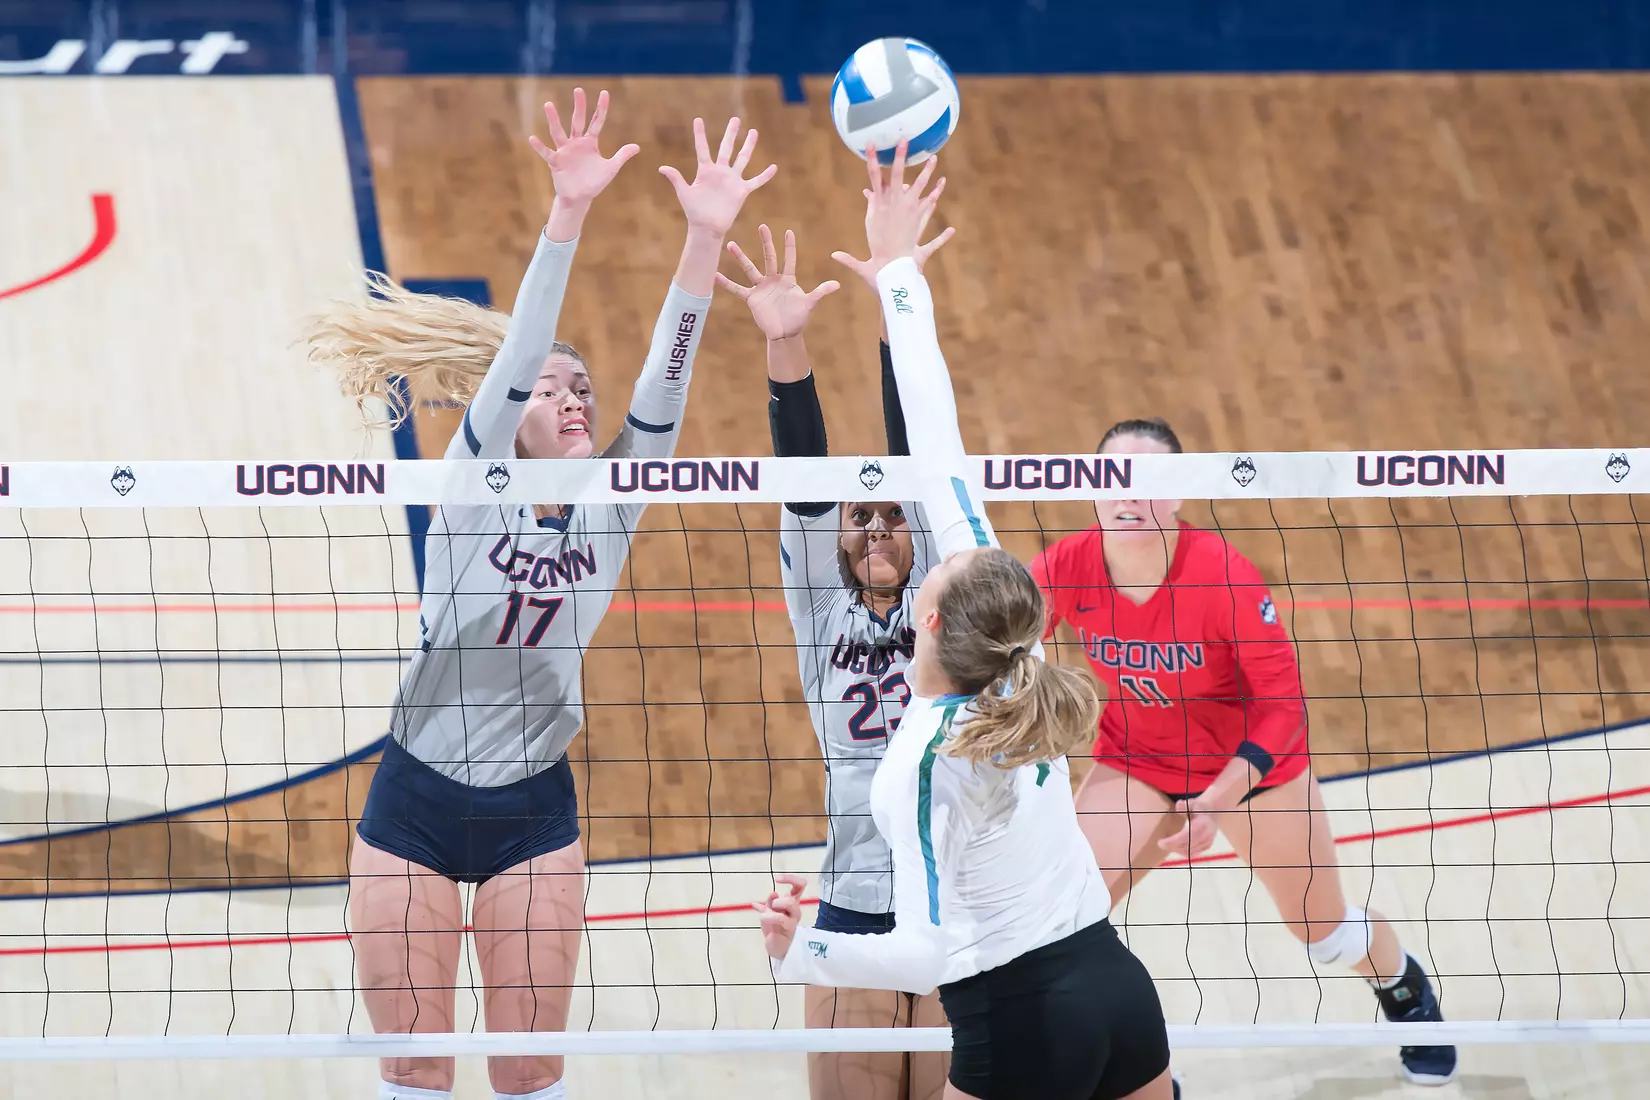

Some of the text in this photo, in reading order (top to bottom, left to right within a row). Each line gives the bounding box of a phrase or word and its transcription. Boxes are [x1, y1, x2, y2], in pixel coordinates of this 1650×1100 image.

[891, 287, 914, 314] Roll
[665, 312, 697, 380] HUSKIES
[237, 463, 385, 497] UCONN
[611, 460, 759, 492] UCONN
[984, 458, 1132, 490] UCONN
[1357, 454, 1505, 486] UCONN
[488, 533, 597, 590] UCONN
[495, 590, 564, 648] 17
[1079, 626, 1206, 674] UCONN
[842, 671, 912, 741] 23
[1120, 675, 1175, 709] 11
